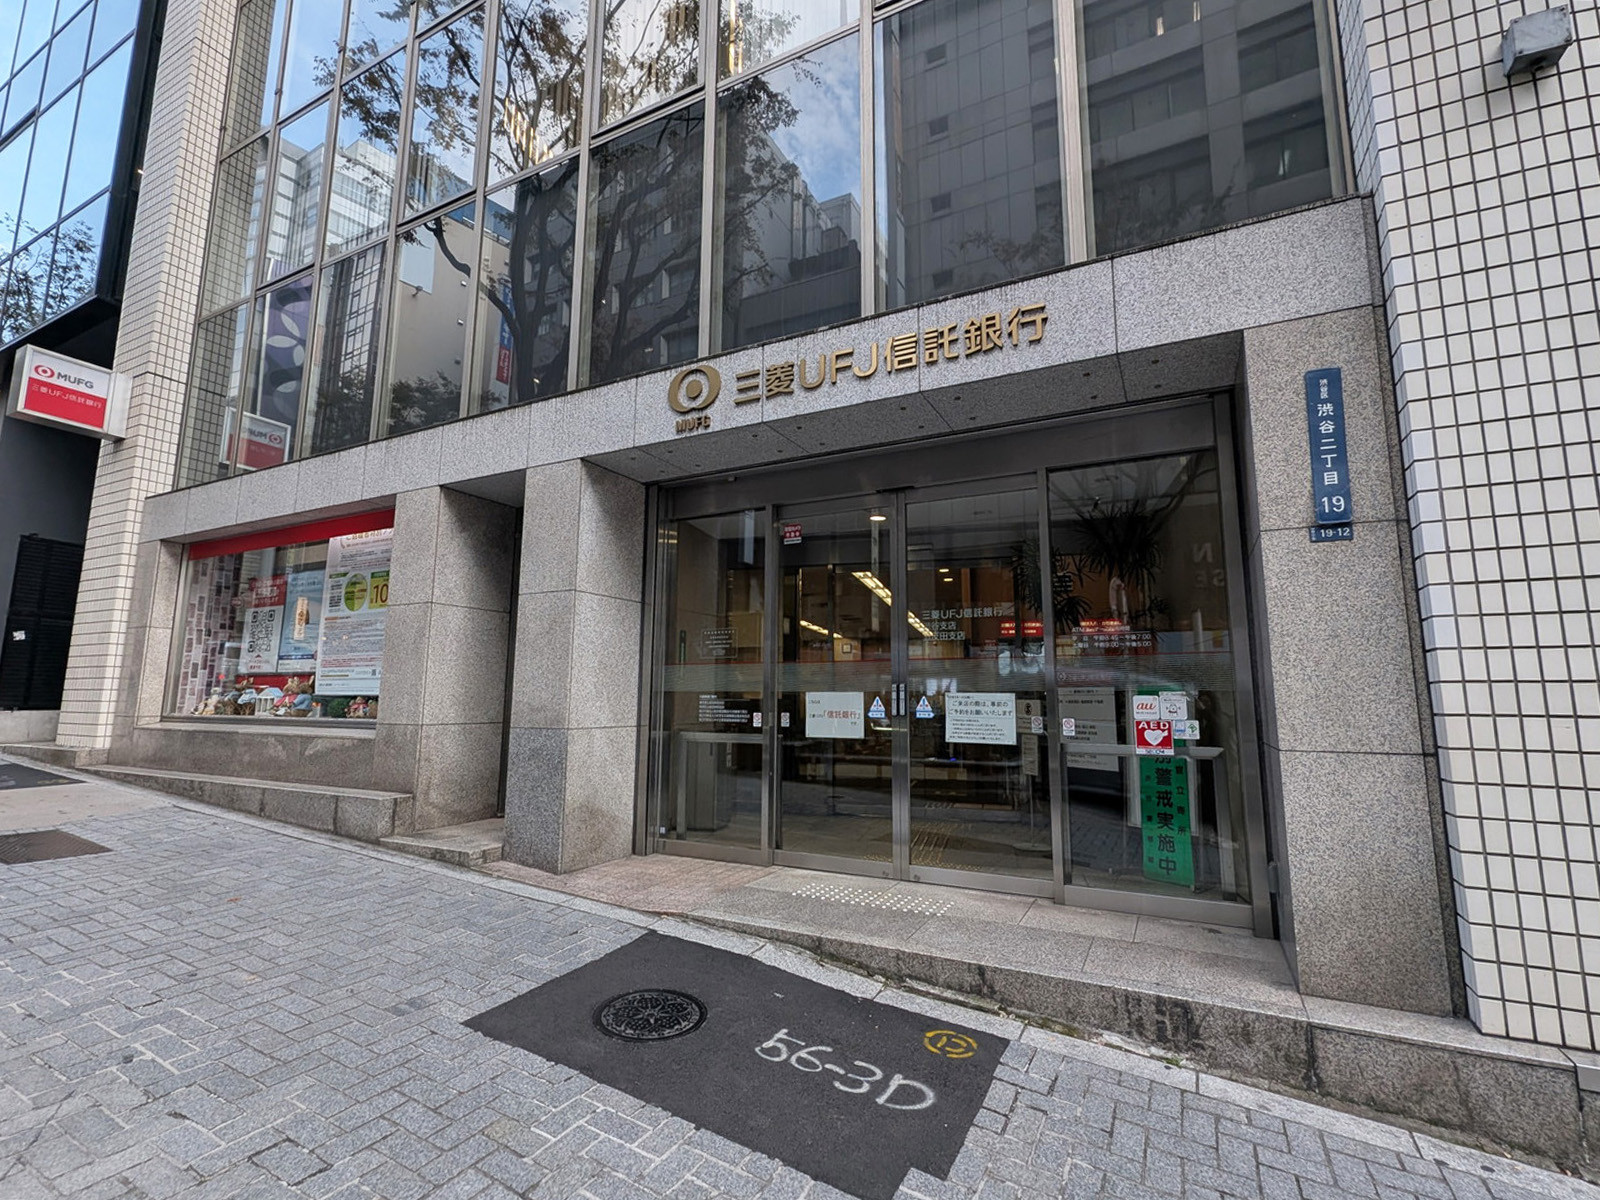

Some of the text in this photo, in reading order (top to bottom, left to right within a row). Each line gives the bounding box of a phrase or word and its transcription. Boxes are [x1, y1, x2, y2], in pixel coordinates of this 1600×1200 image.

[733, 303, 1048, 405] 三菱UFJ信託銀行
[57, 372, 94, 389] MUFG
[675, 415, 711, 433] MUFG
[1317, 403, 1339, 486] 渋谷二丁目
[1321, 495, 1345, 513] 19
[1320, 527, 1350, 538] 19-12
[1136, 702, 1156, 711] au
[1138, 721, 1169, 730] AED
[755, 1028, 936, 1110] 56-3D
